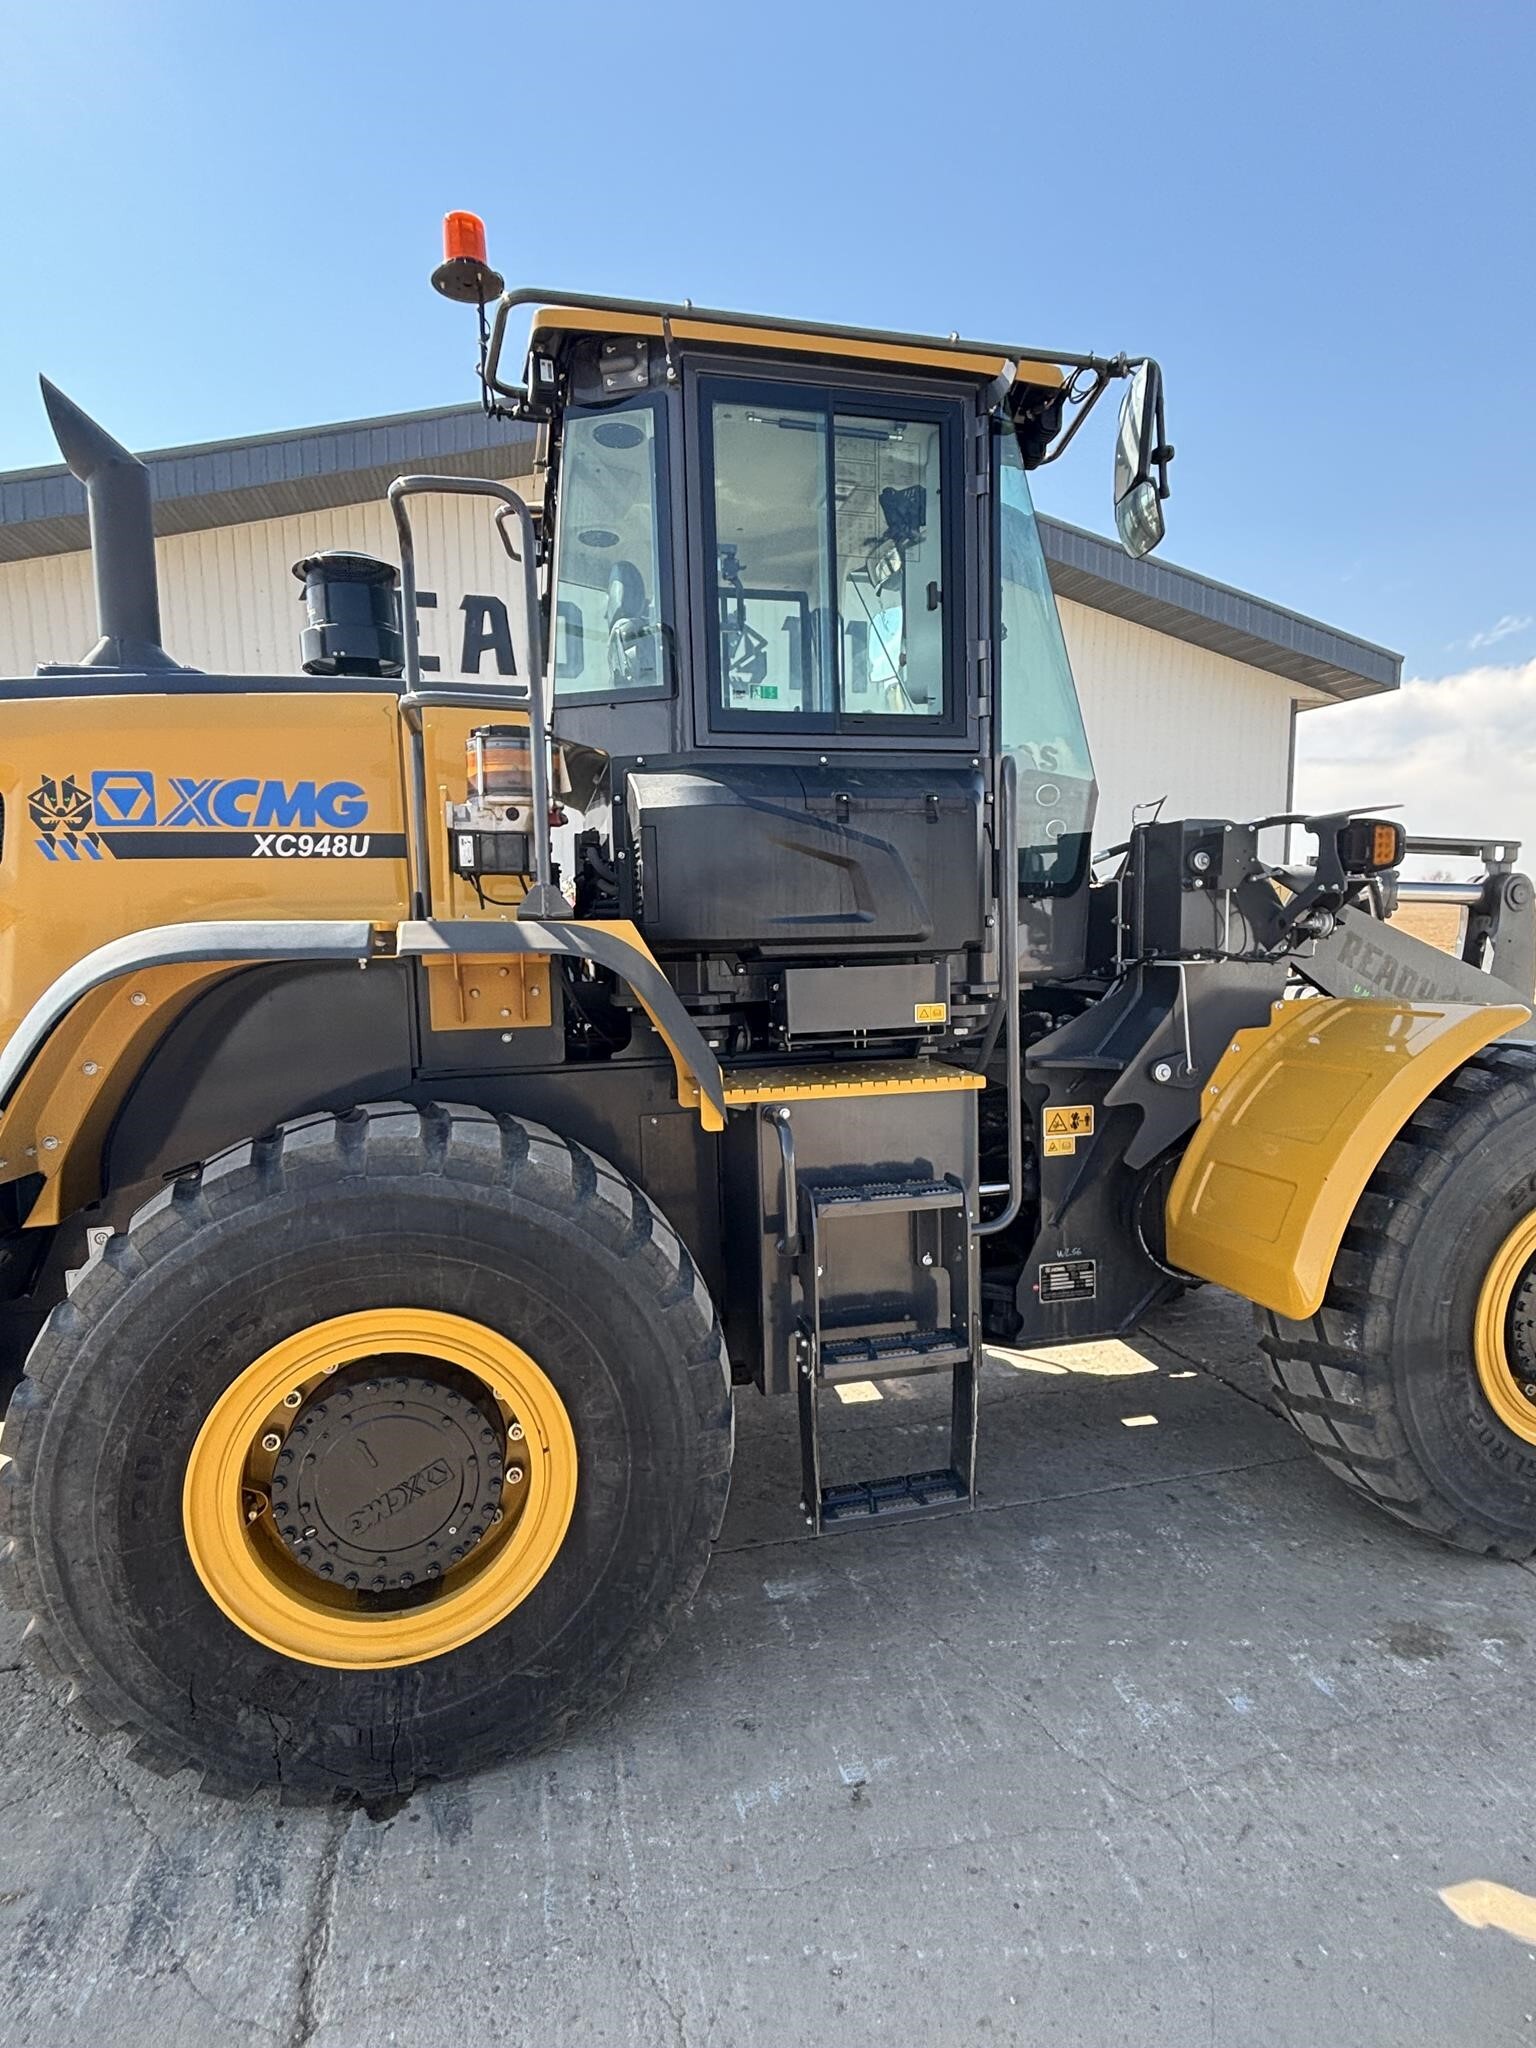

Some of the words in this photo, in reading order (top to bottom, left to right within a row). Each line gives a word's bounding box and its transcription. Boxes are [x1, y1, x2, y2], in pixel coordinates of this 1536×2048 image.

[158, 777, 369, 829] XCMG
[251, 834, 371, 857] XC948U
[346, 1471, 427, 1537] XCMG
